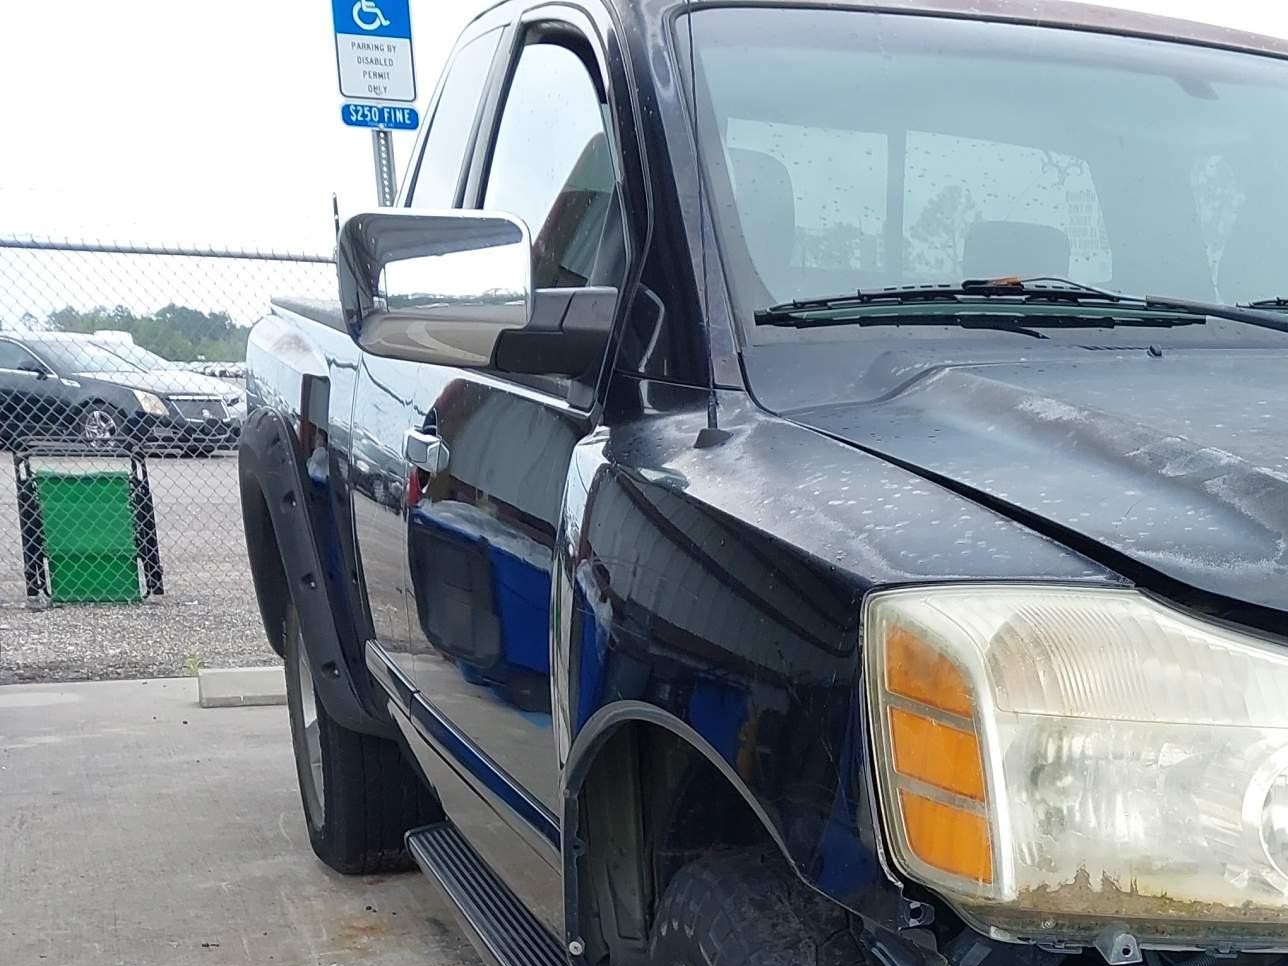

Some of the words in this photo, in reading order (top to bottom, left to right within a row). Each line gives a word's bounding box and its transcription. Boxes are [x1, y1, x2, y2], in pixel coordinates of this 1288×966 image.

[351, 41, 385, 52] PARKING
[386, 44, 397, 53] BY
[356, 56, 394, 67] DISABLED
[362, 70, 390, 80] PERMIT
[367, 85, 388, 94] ONLY
[349, 104, 379, 122] $250
[383, 107, 411, 124] FINE
